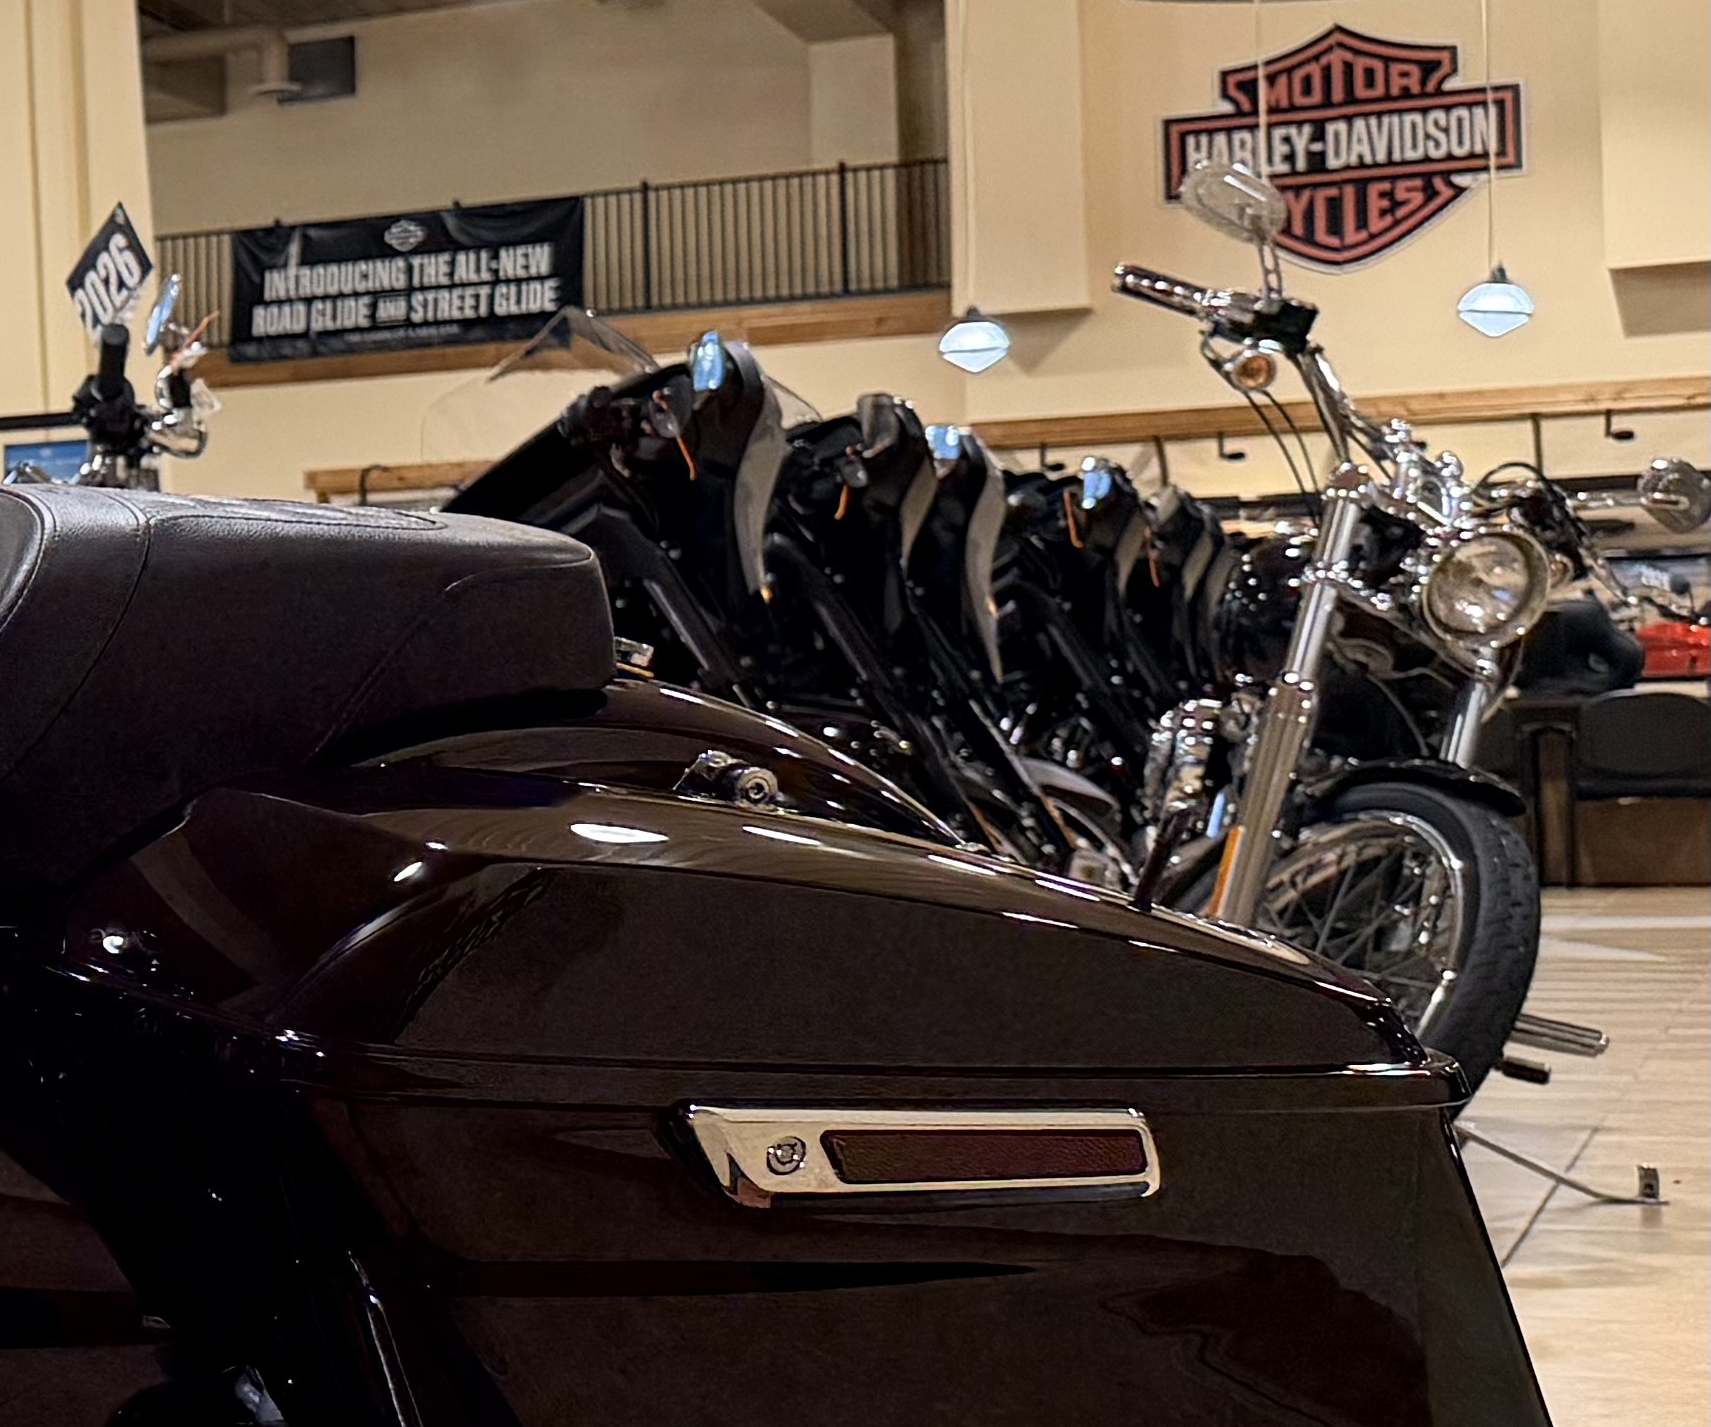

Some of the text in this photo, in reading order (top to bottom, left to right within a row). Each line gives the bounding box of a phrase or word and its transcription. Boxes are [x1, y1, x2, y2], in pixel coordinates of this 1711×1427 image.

[1264, 49, 1422, 109] MOTOR
[1184, 104, 1496, 173] HARLEY-DAVIDSON
[1284, 174, 1426, 250] YCLES
[73, 233, 142, 334] 2026
[263, 241, 554, 302] INTRODUCING THE ALL-NEW
[251, 299, 308, 338] ROAD
[309, 294, 375, 334] GLIDE
[376, 294, 408, 323] AND
[409, 285, 492, 324] STREET
[493, 277, 561, 317] GLIDE
